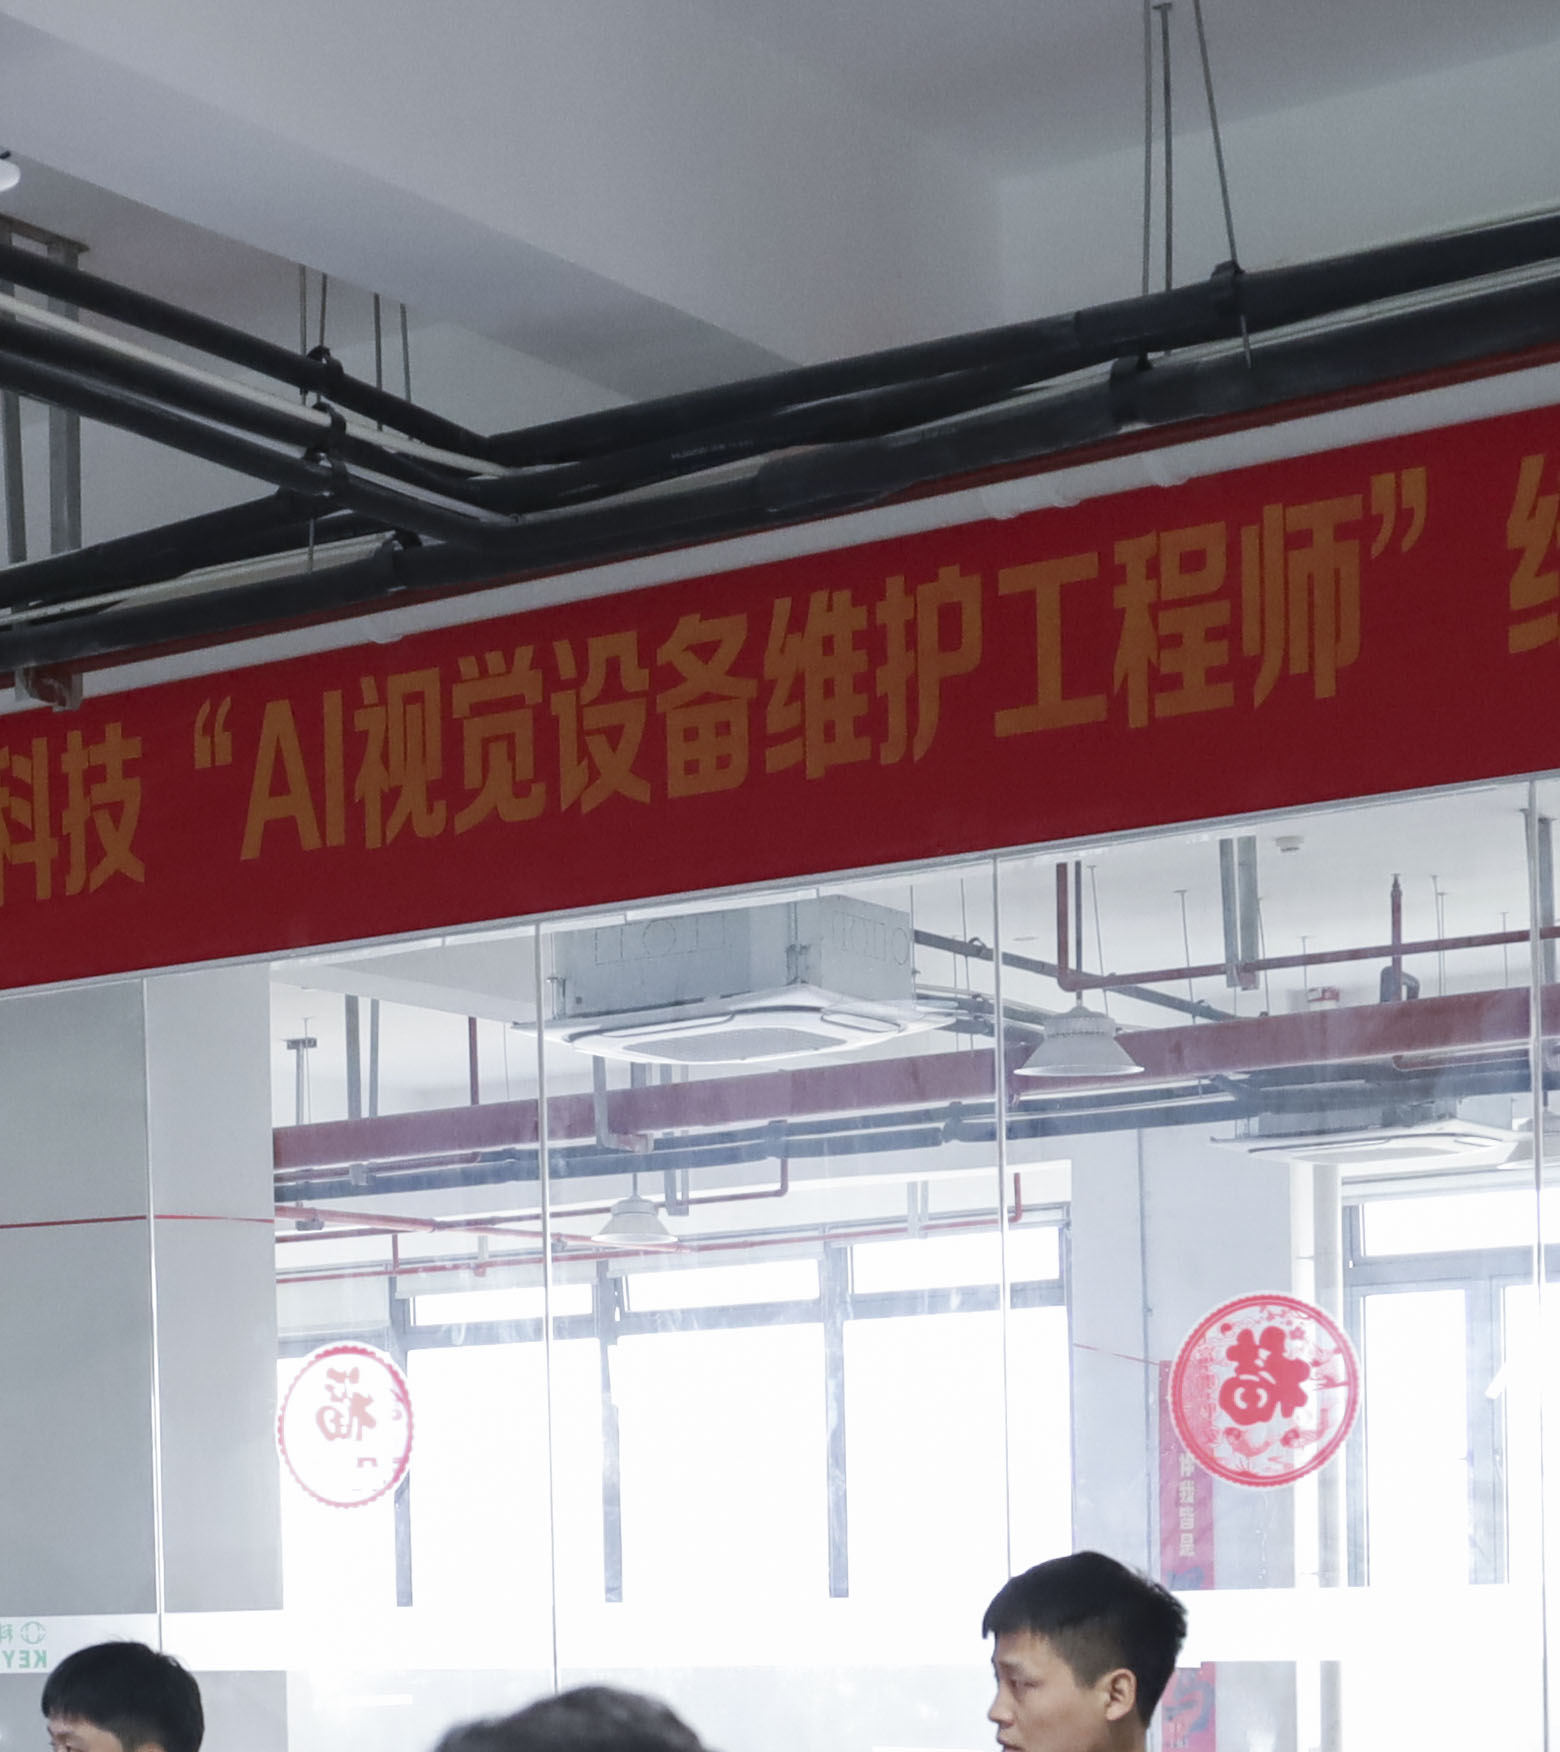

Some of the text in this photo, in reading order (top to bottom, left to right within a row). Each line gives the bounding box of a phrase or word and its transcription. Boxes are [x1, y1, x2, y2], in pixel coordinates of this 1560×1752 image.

[192, 466, 1429, 861] “AI视觉设备维护工程师”
